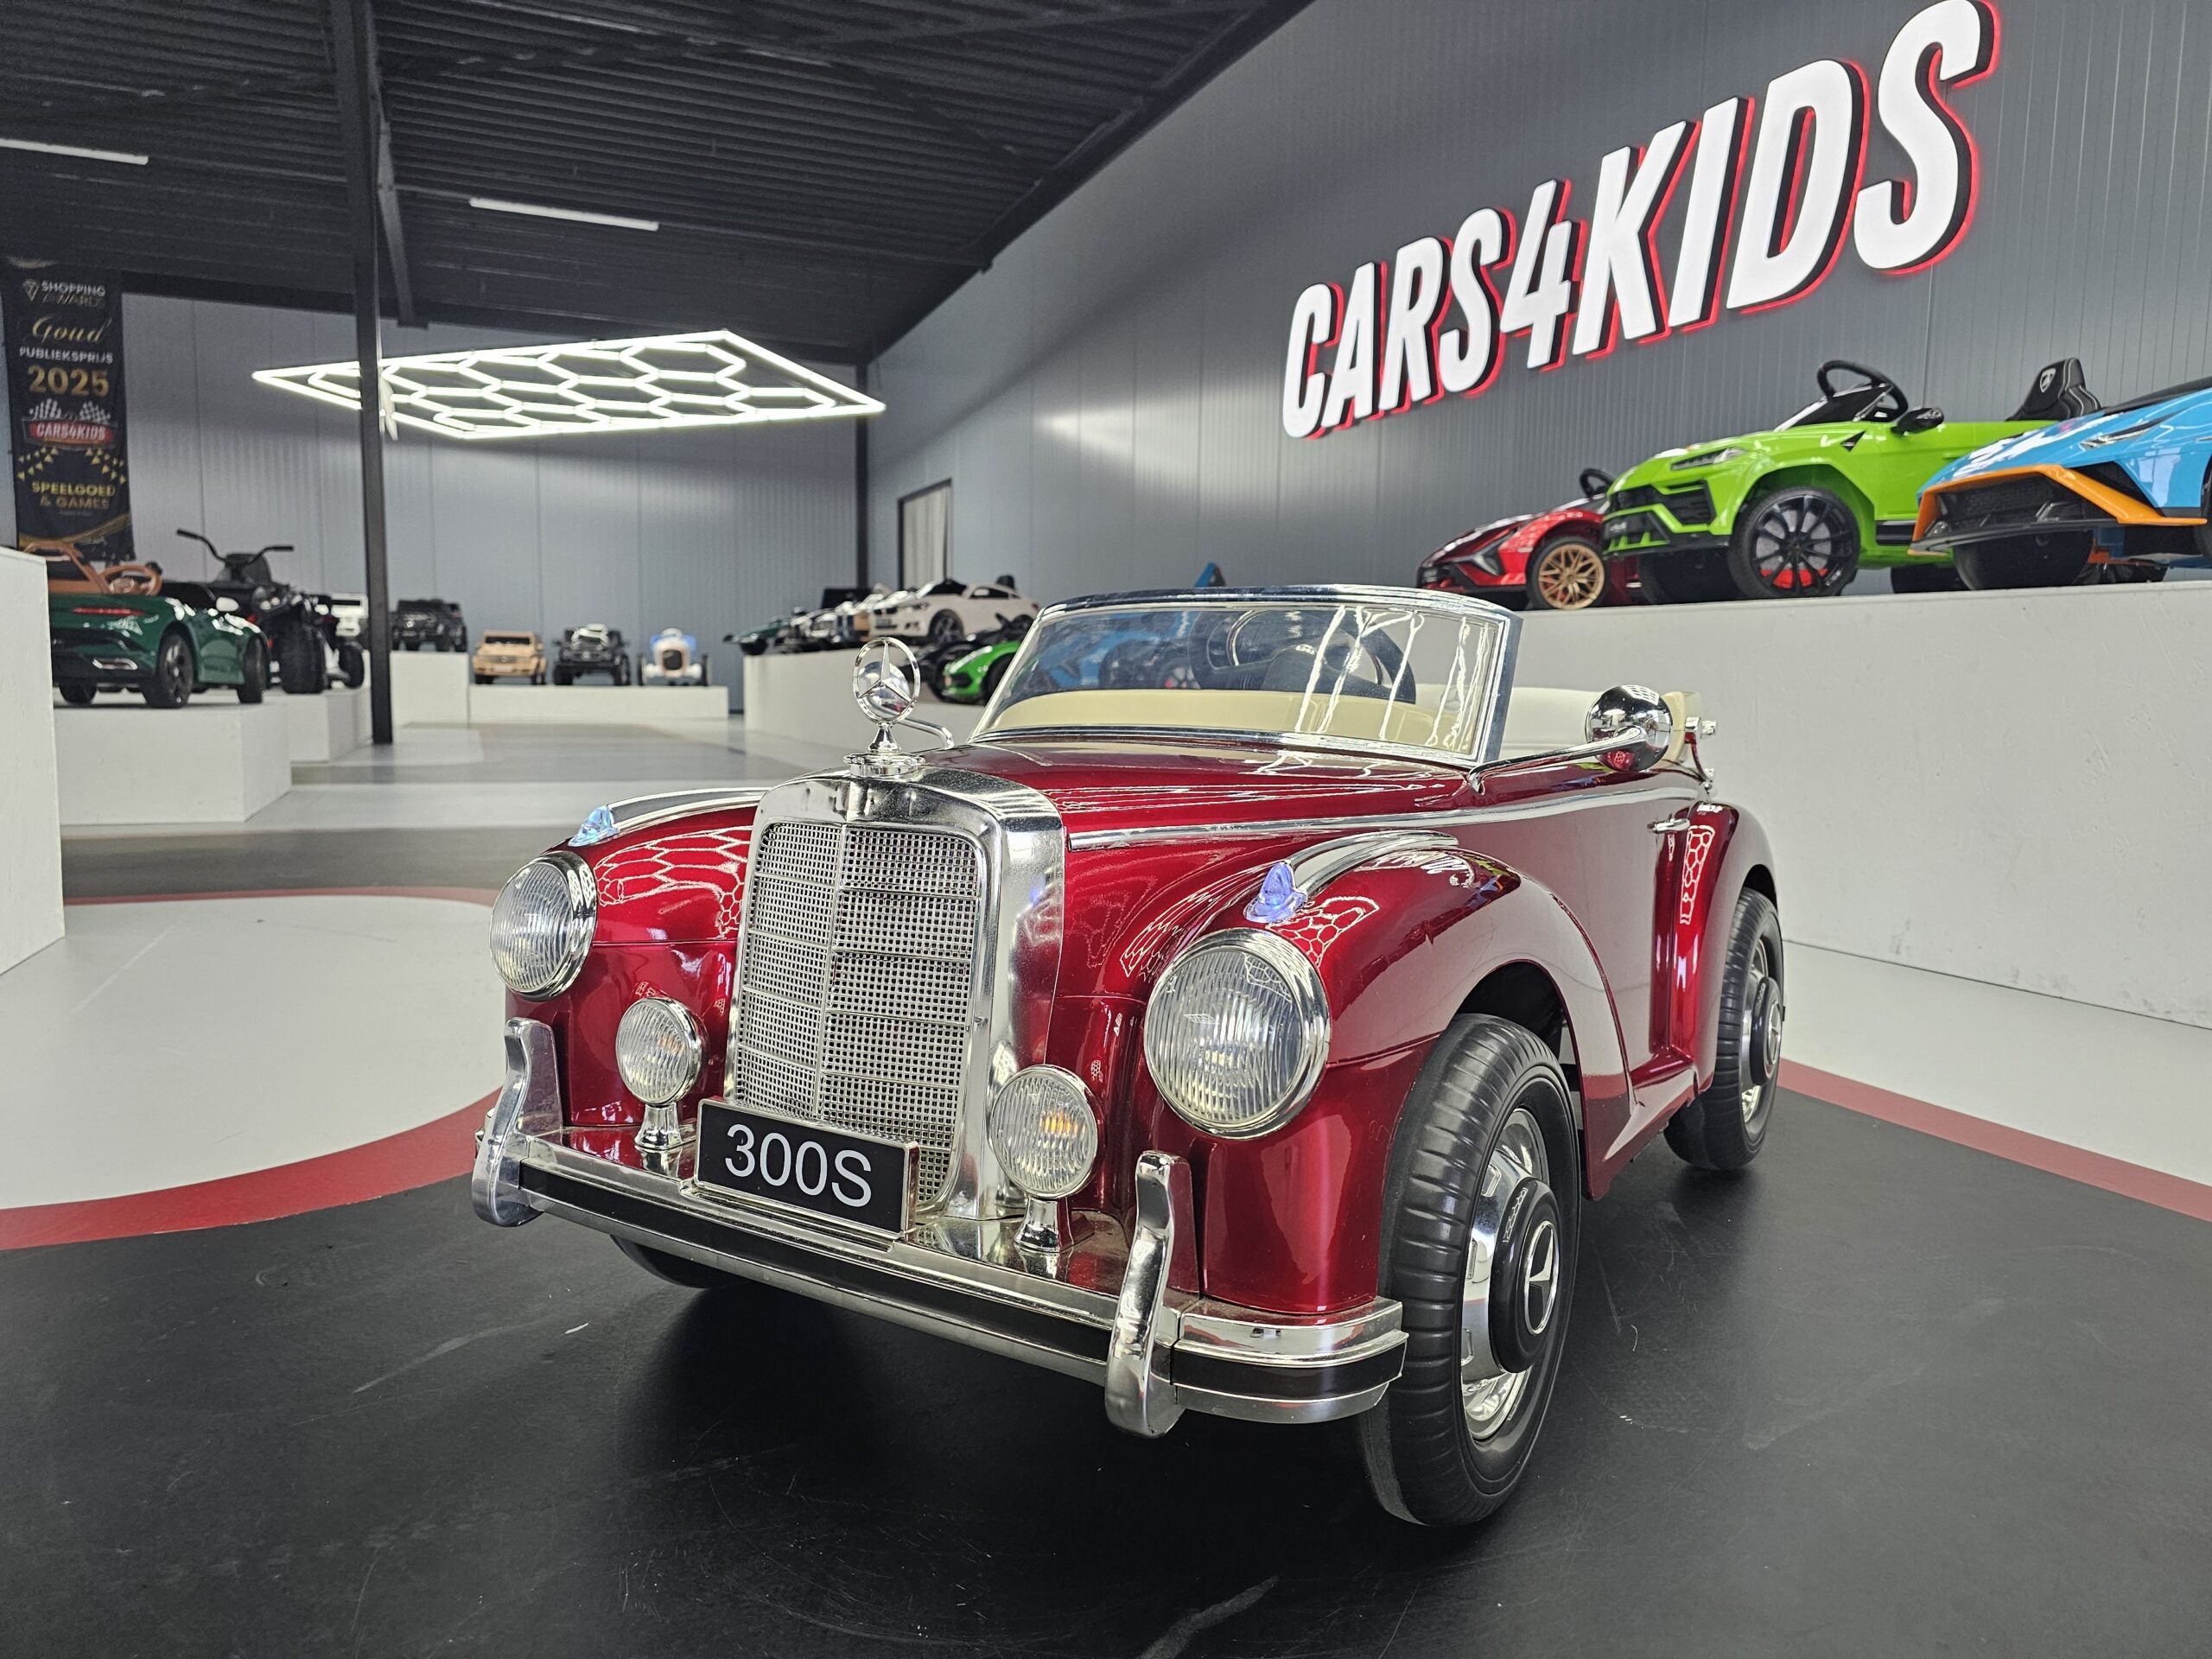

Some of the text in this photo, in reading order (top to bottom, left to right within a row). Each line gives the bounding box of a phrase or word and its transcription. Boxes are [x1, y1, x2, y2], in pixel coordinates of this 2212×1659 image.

[1283, 0, 1998, 438] CARS4KIDS
[41, 280, 105, 297] SHOPPING
[32, 314, 112, 343] Goud
[19, 346, 113, 365] PUBLIEKSPRIJS
[28, 365, 110, 397] 2025
[36, 423, 106, 441] CARS4KIDS
[32, 480, 116, 497] SPEELGOED
[55, 496, 110, 510] GAMES
[725, 1123, 872, 1208] 300S
